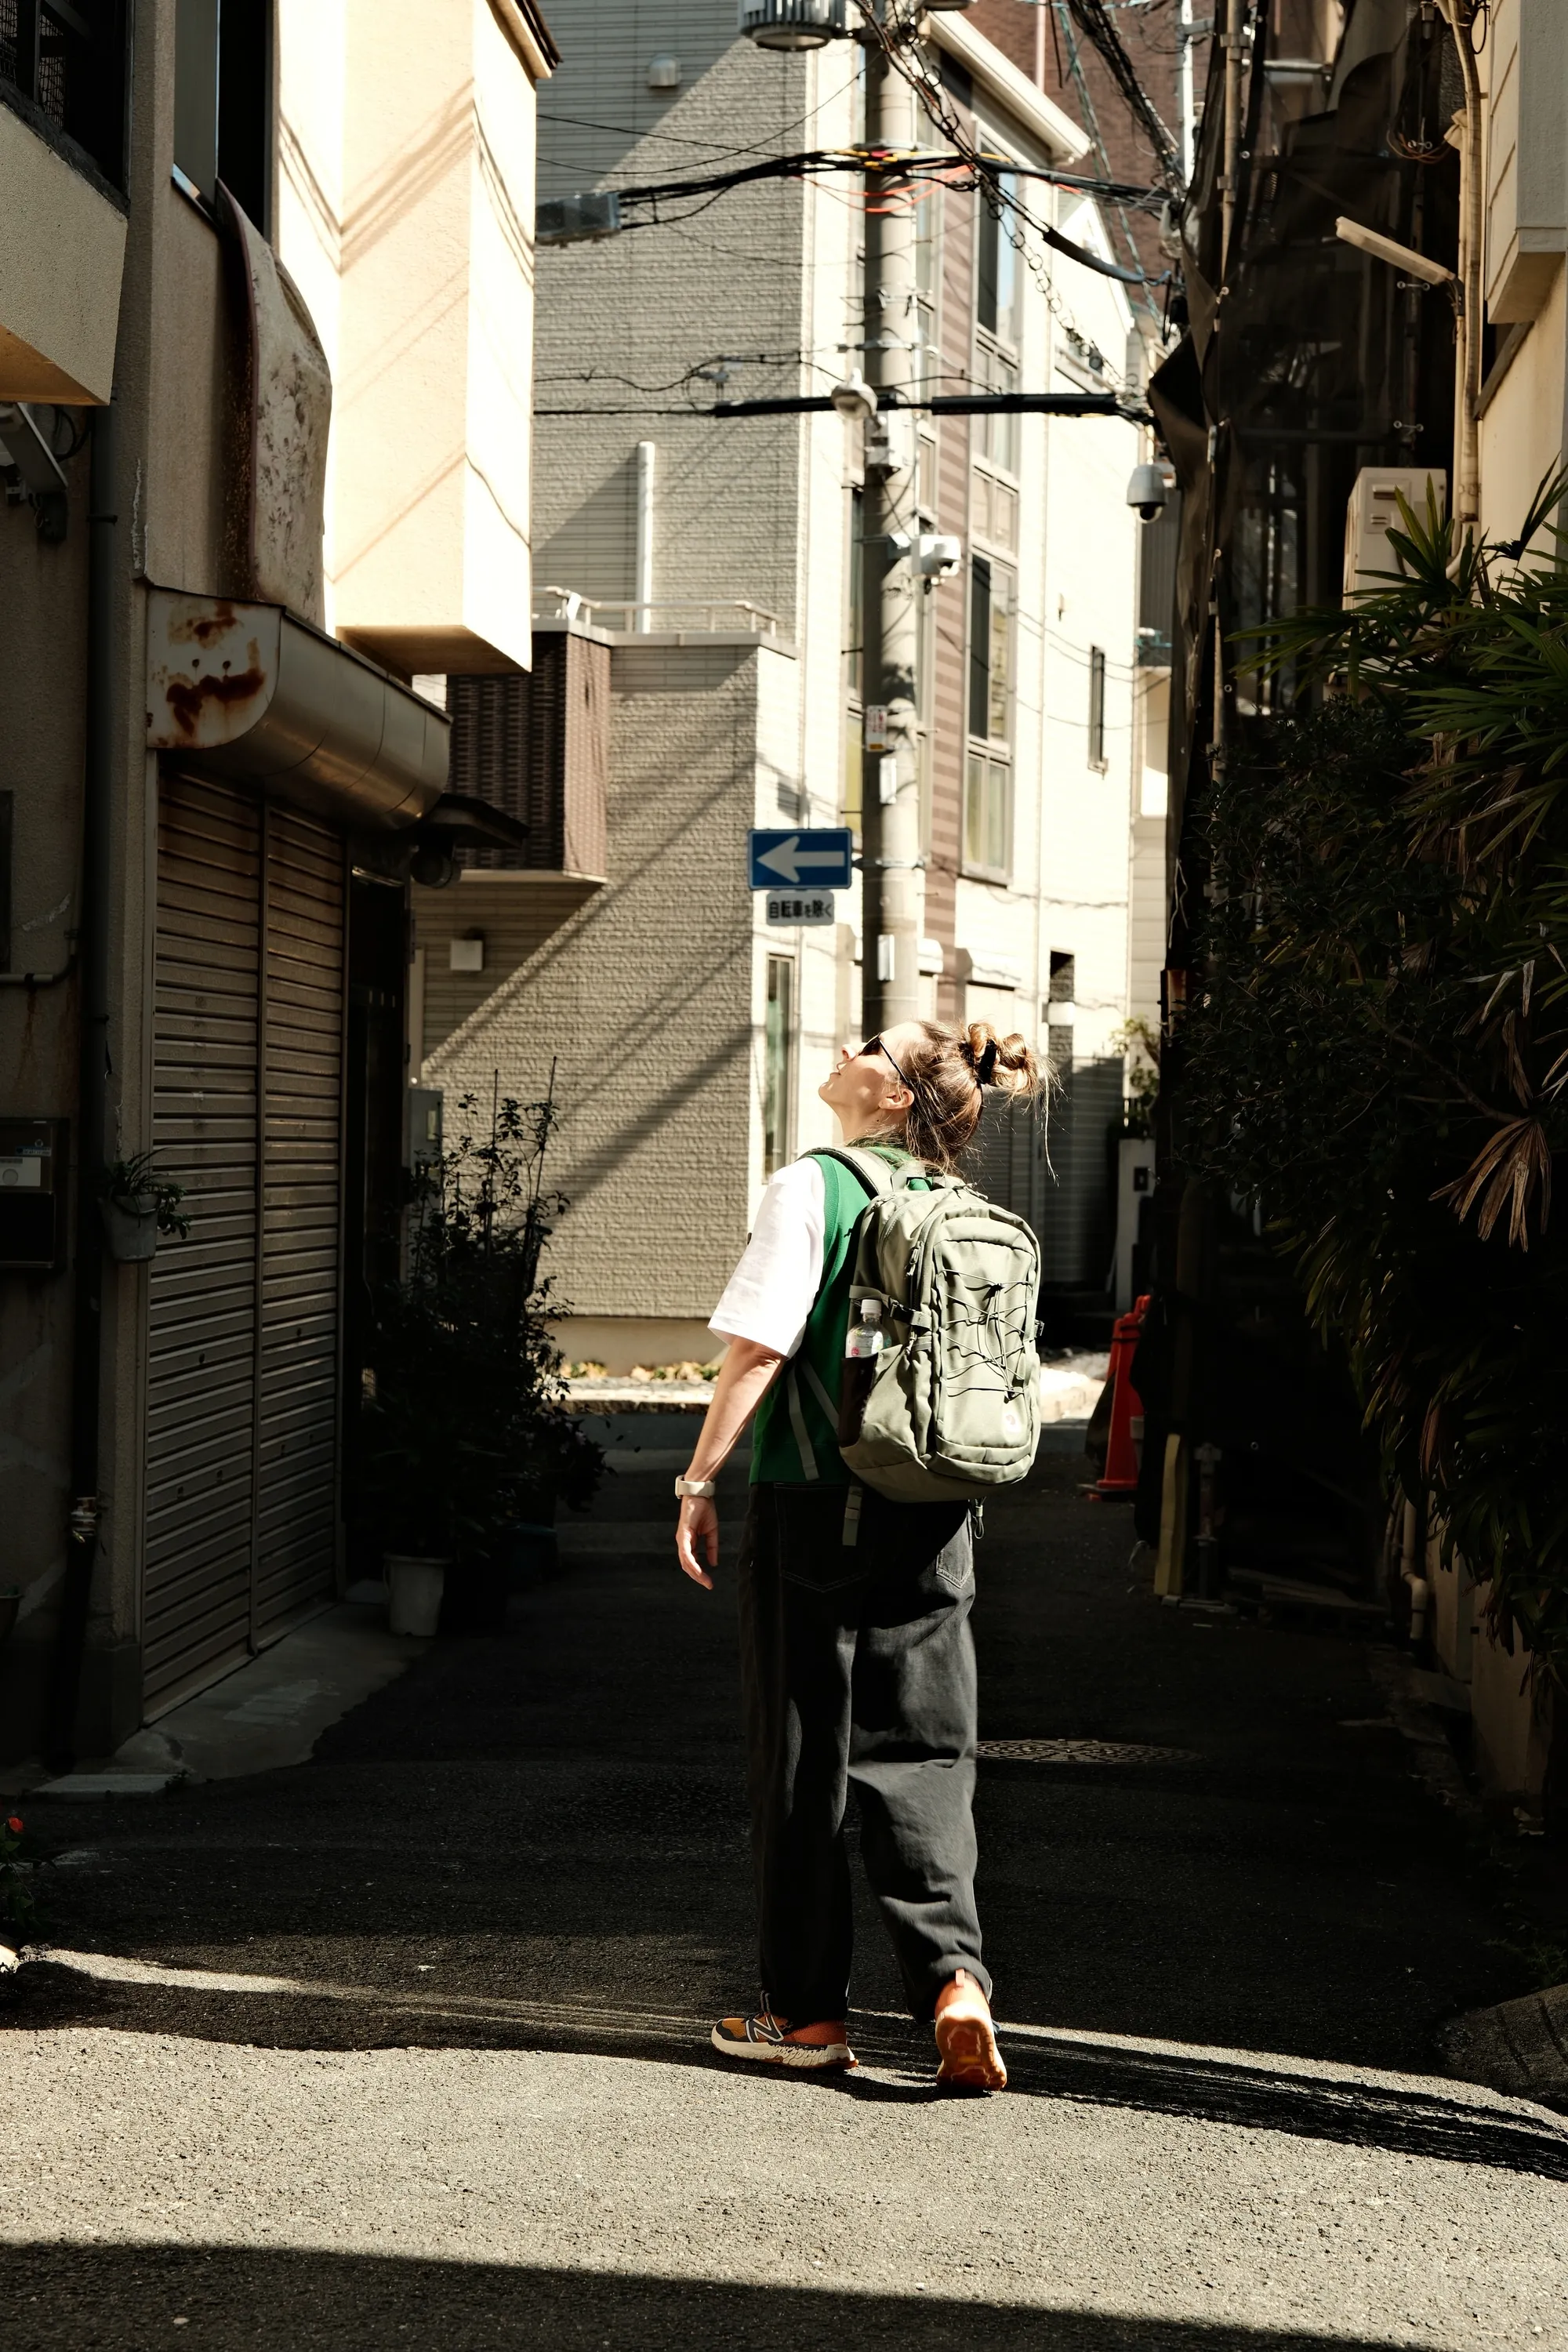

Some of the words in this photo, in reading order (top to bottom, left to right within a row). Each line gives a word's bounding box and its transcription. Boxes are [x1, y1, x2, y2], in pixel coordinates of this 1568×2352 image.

[769, 899, 833, 919] 自転車を除く
